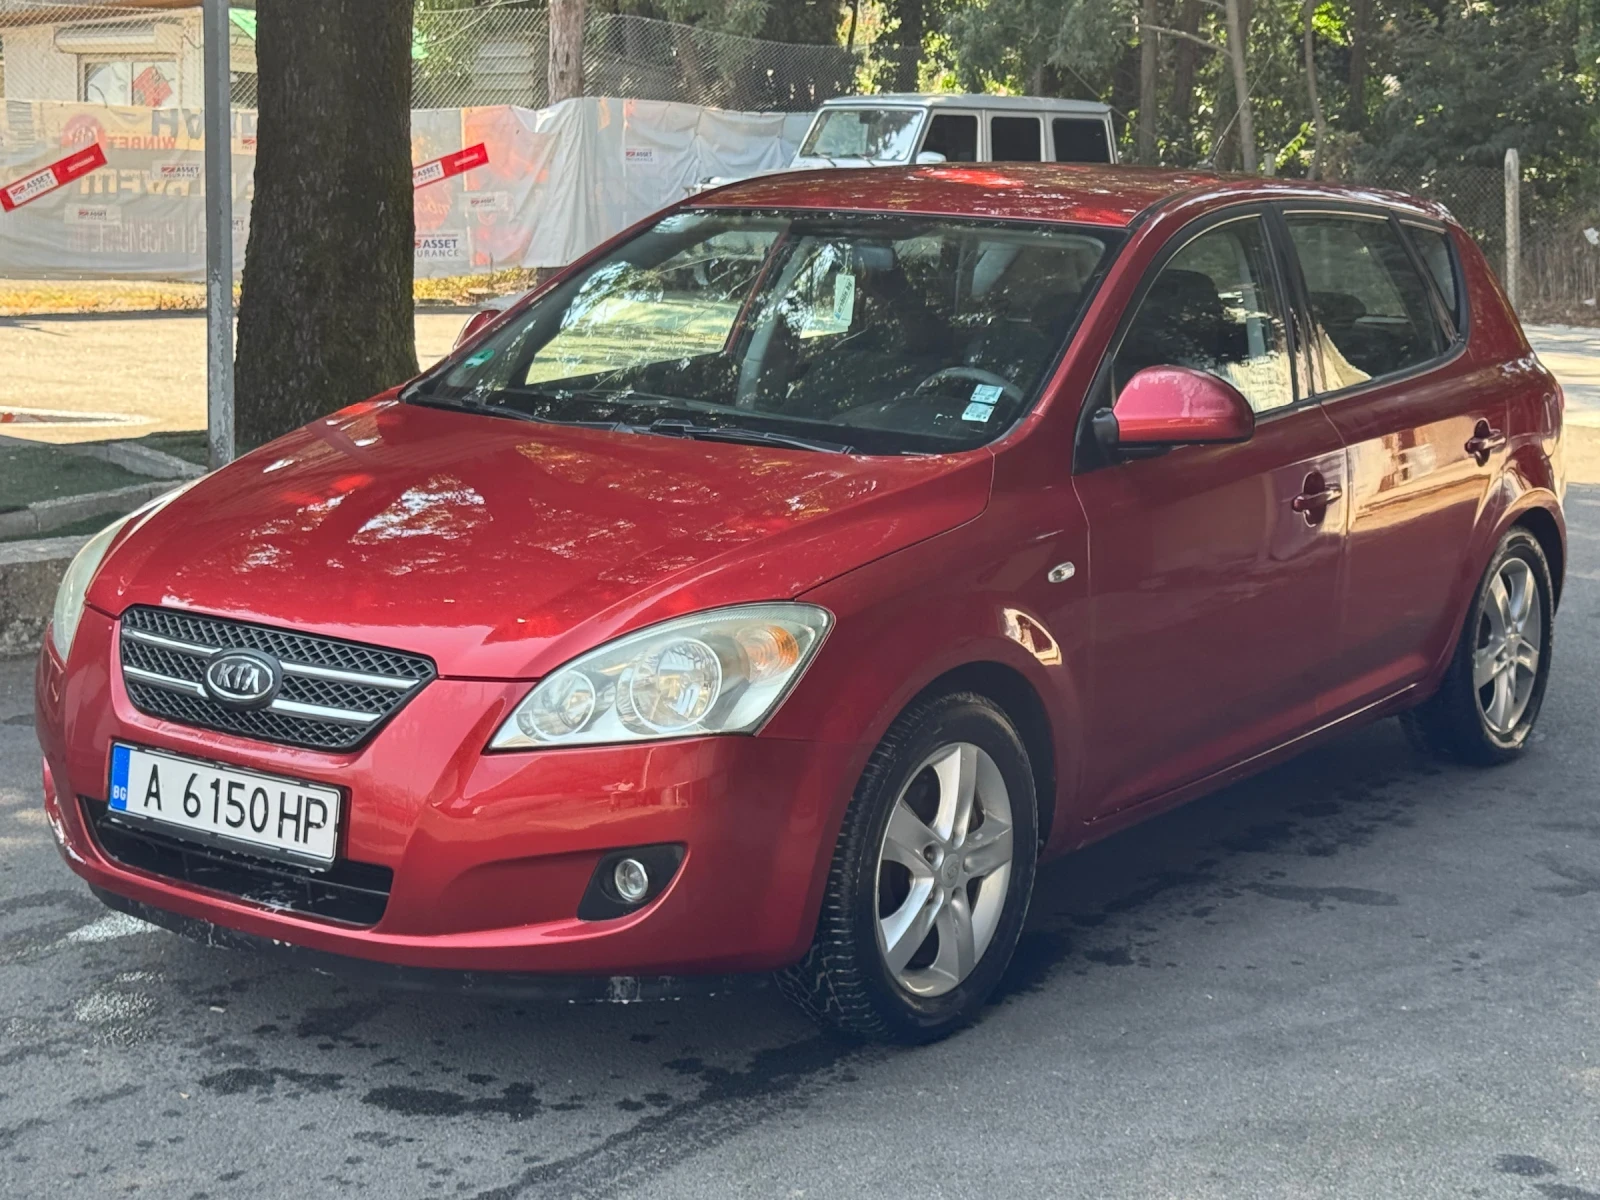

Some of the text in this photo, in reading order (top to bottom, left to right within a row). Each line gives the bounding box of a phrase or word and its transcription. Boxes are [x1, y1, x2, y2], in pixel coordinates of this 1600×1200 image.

[176, 166, 199, 174] ASSET
[417, 163, 440, 176] ASSET
[26, 172, 51, 190] ASSET
[422, 239, 459, 249] ASSET
[416, 249, 459, 259] URANCE
[216, 663, 260, 693] KIA
[112, 784, 127, 801] BG
[143, 763, 328, 844] A 6150 HP
